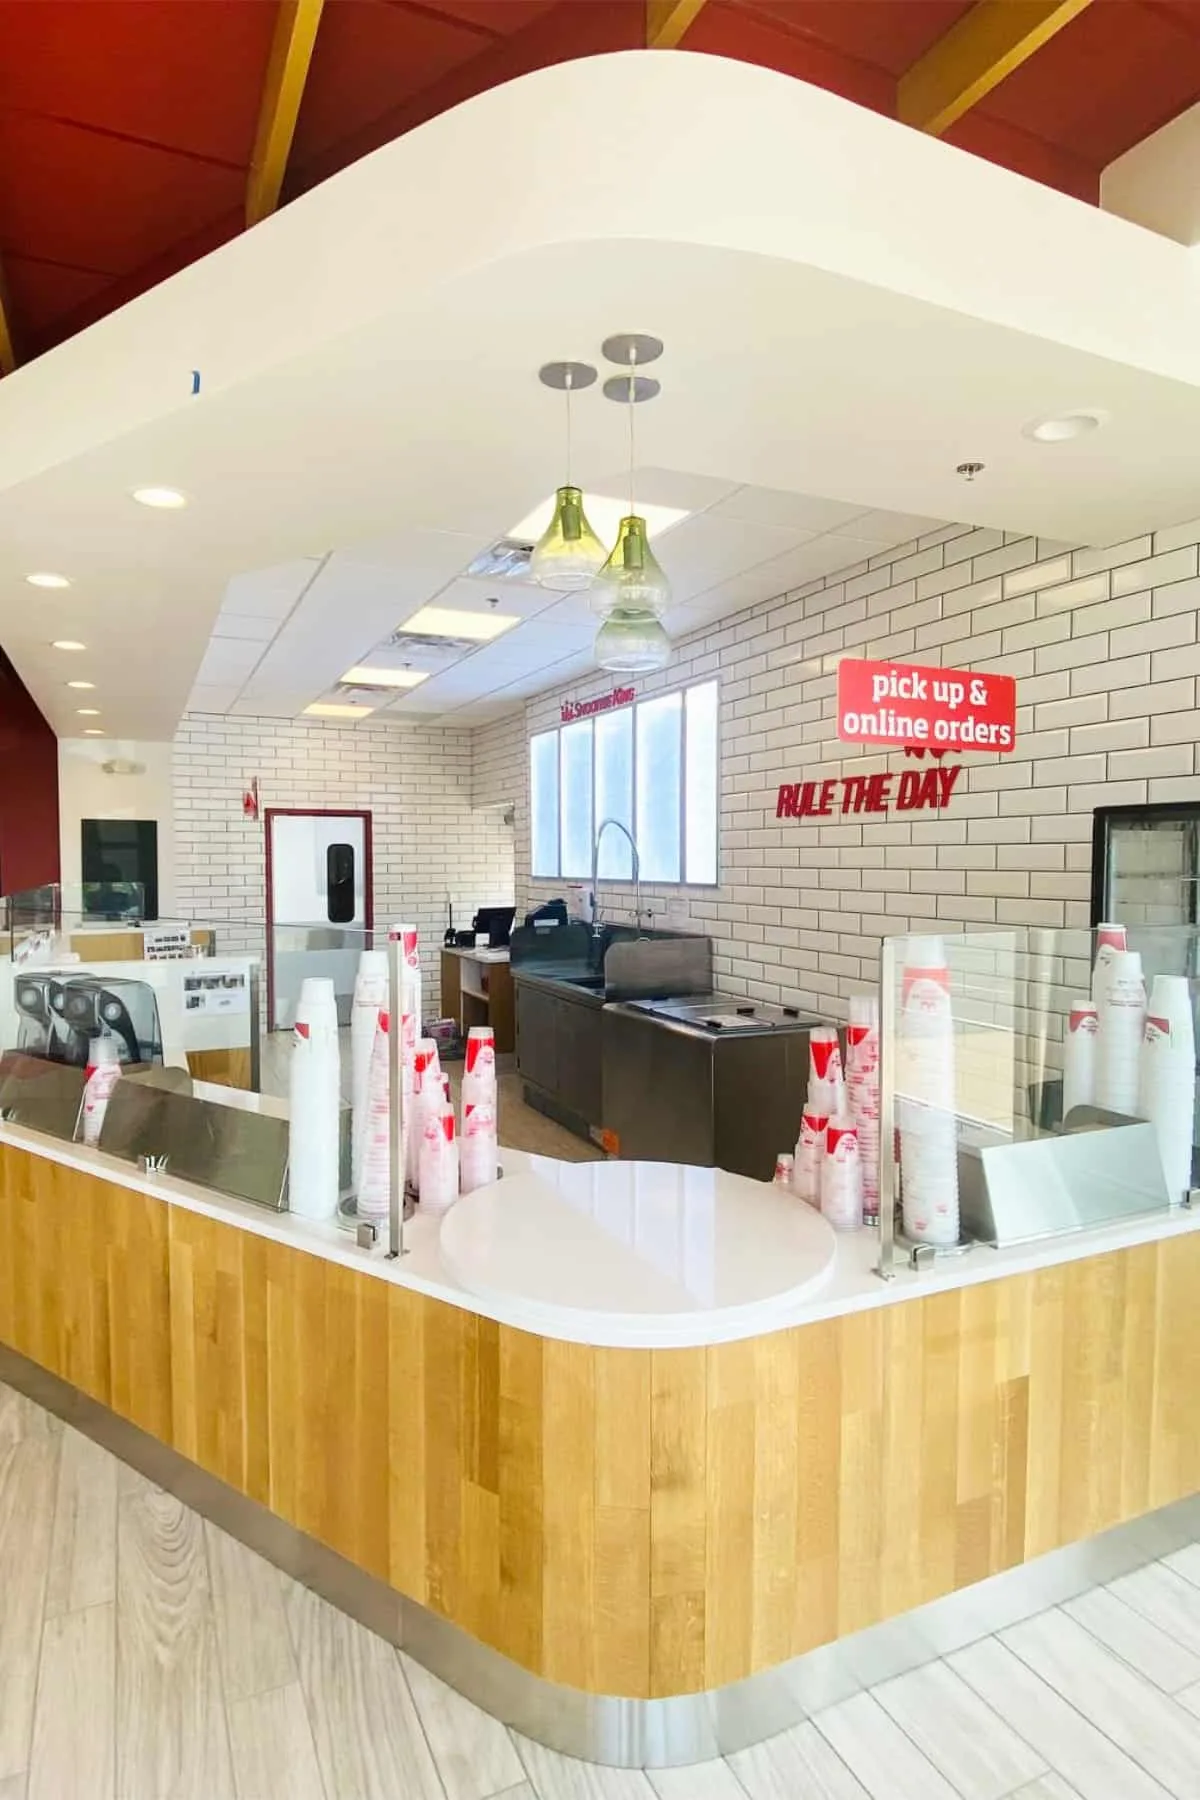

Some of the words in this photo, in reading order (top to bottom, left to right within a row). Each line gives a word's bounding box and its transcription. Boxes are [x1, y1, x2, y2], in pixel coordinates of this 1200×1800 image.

[872, 670, 927, 704] pick
[933, 680, 965, 709] up
[969, 679, 988, 706] &
[843, 709, 929, 739] online
[934, 716, 1011, 745] orders
[776, 779, 838, 818] RULE
[840, 772, 894, 814] THE
[896, 766, 962, 811] DAY
